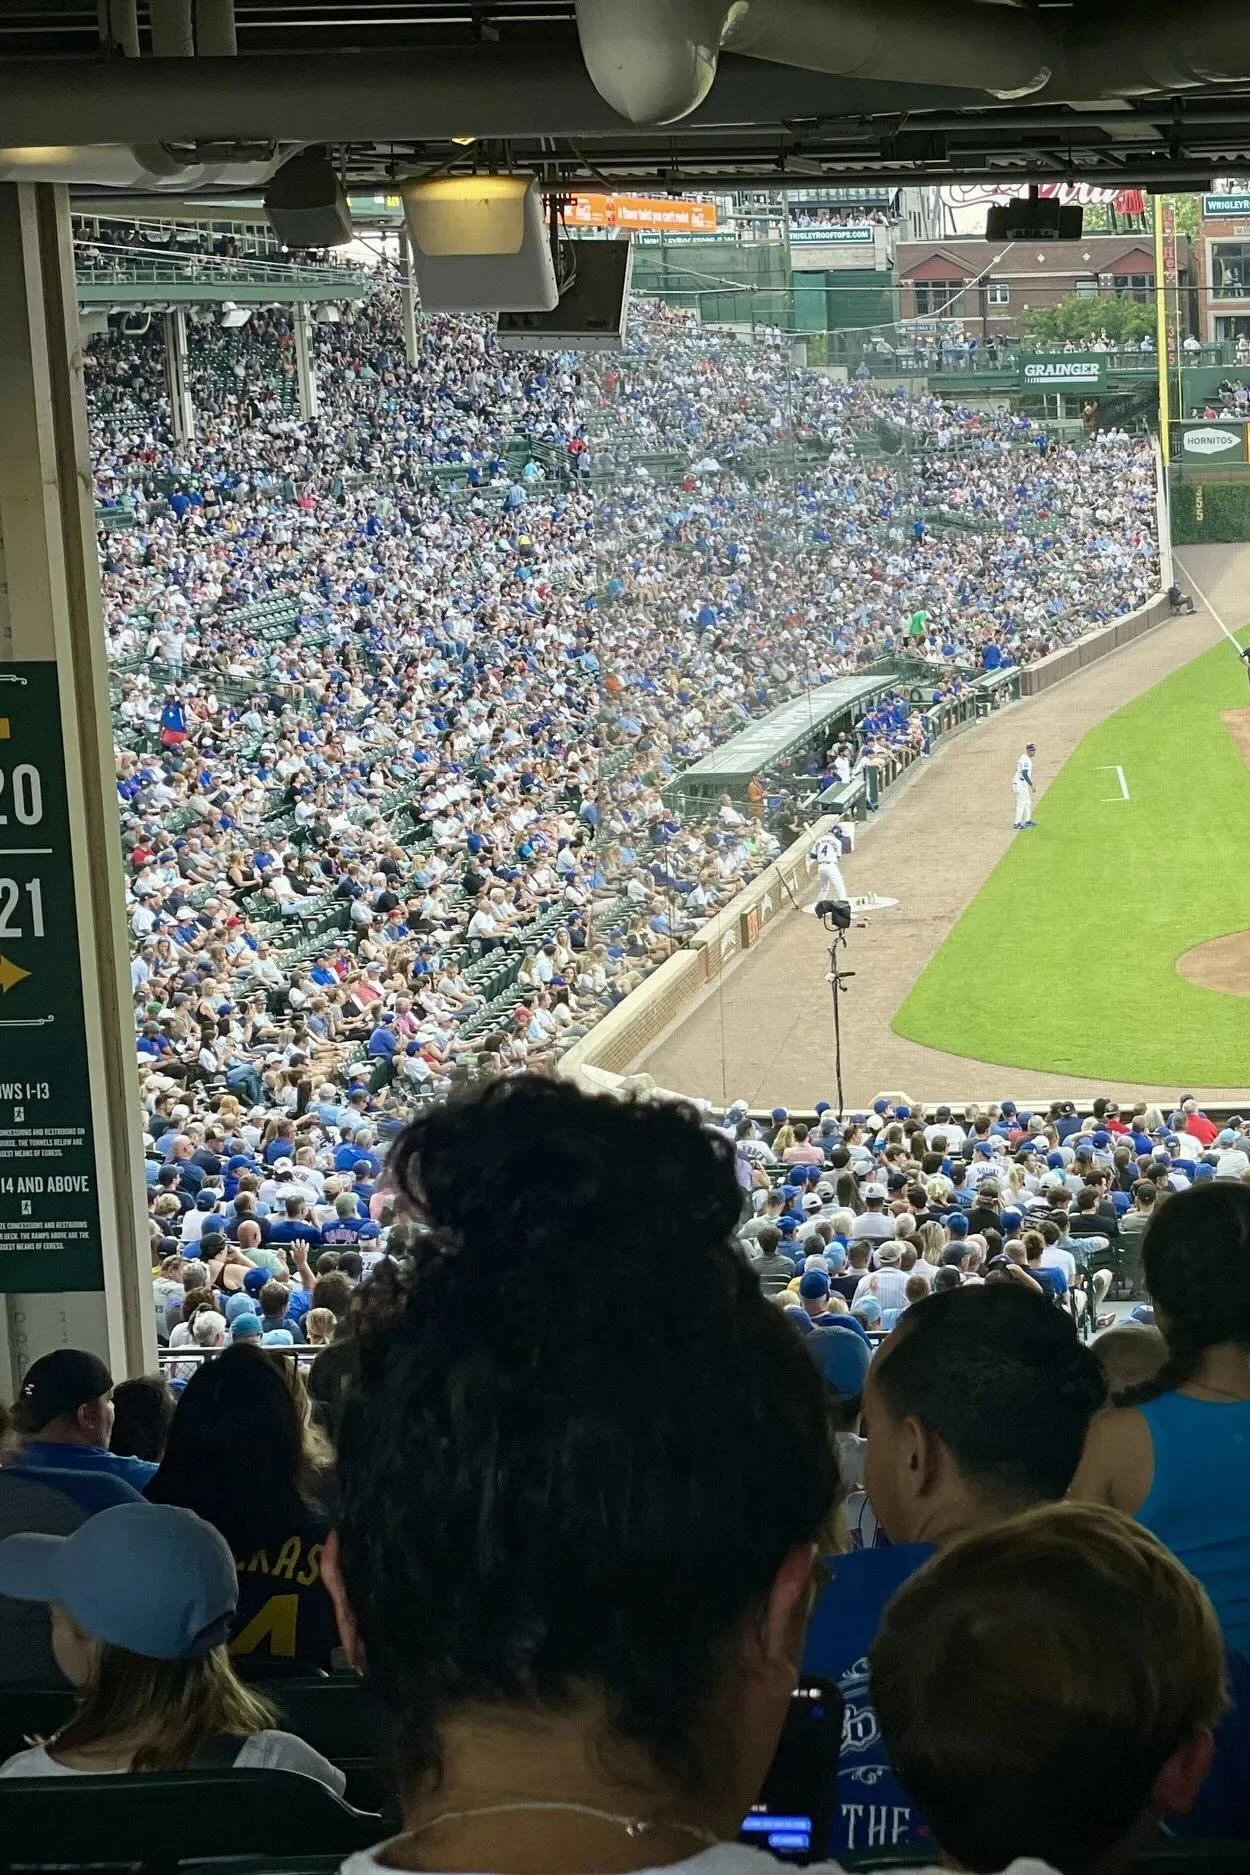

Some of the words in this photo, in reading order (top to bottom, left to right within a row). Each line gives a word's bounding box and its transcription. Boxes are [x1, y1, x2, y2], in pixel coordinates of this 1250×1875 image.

[1024, 363, 1100, 377] GRAINGER
[1188, 436, 1233, 446] HORNITOS
[0, 763, 43, 825] 0
[0, 1082, 23, 1100] WS
[26, 1082, 50, 1099] 1-13
[17, 1176, 44, 1193] AND
[47, 1175, 89, 1192] ABOVE
